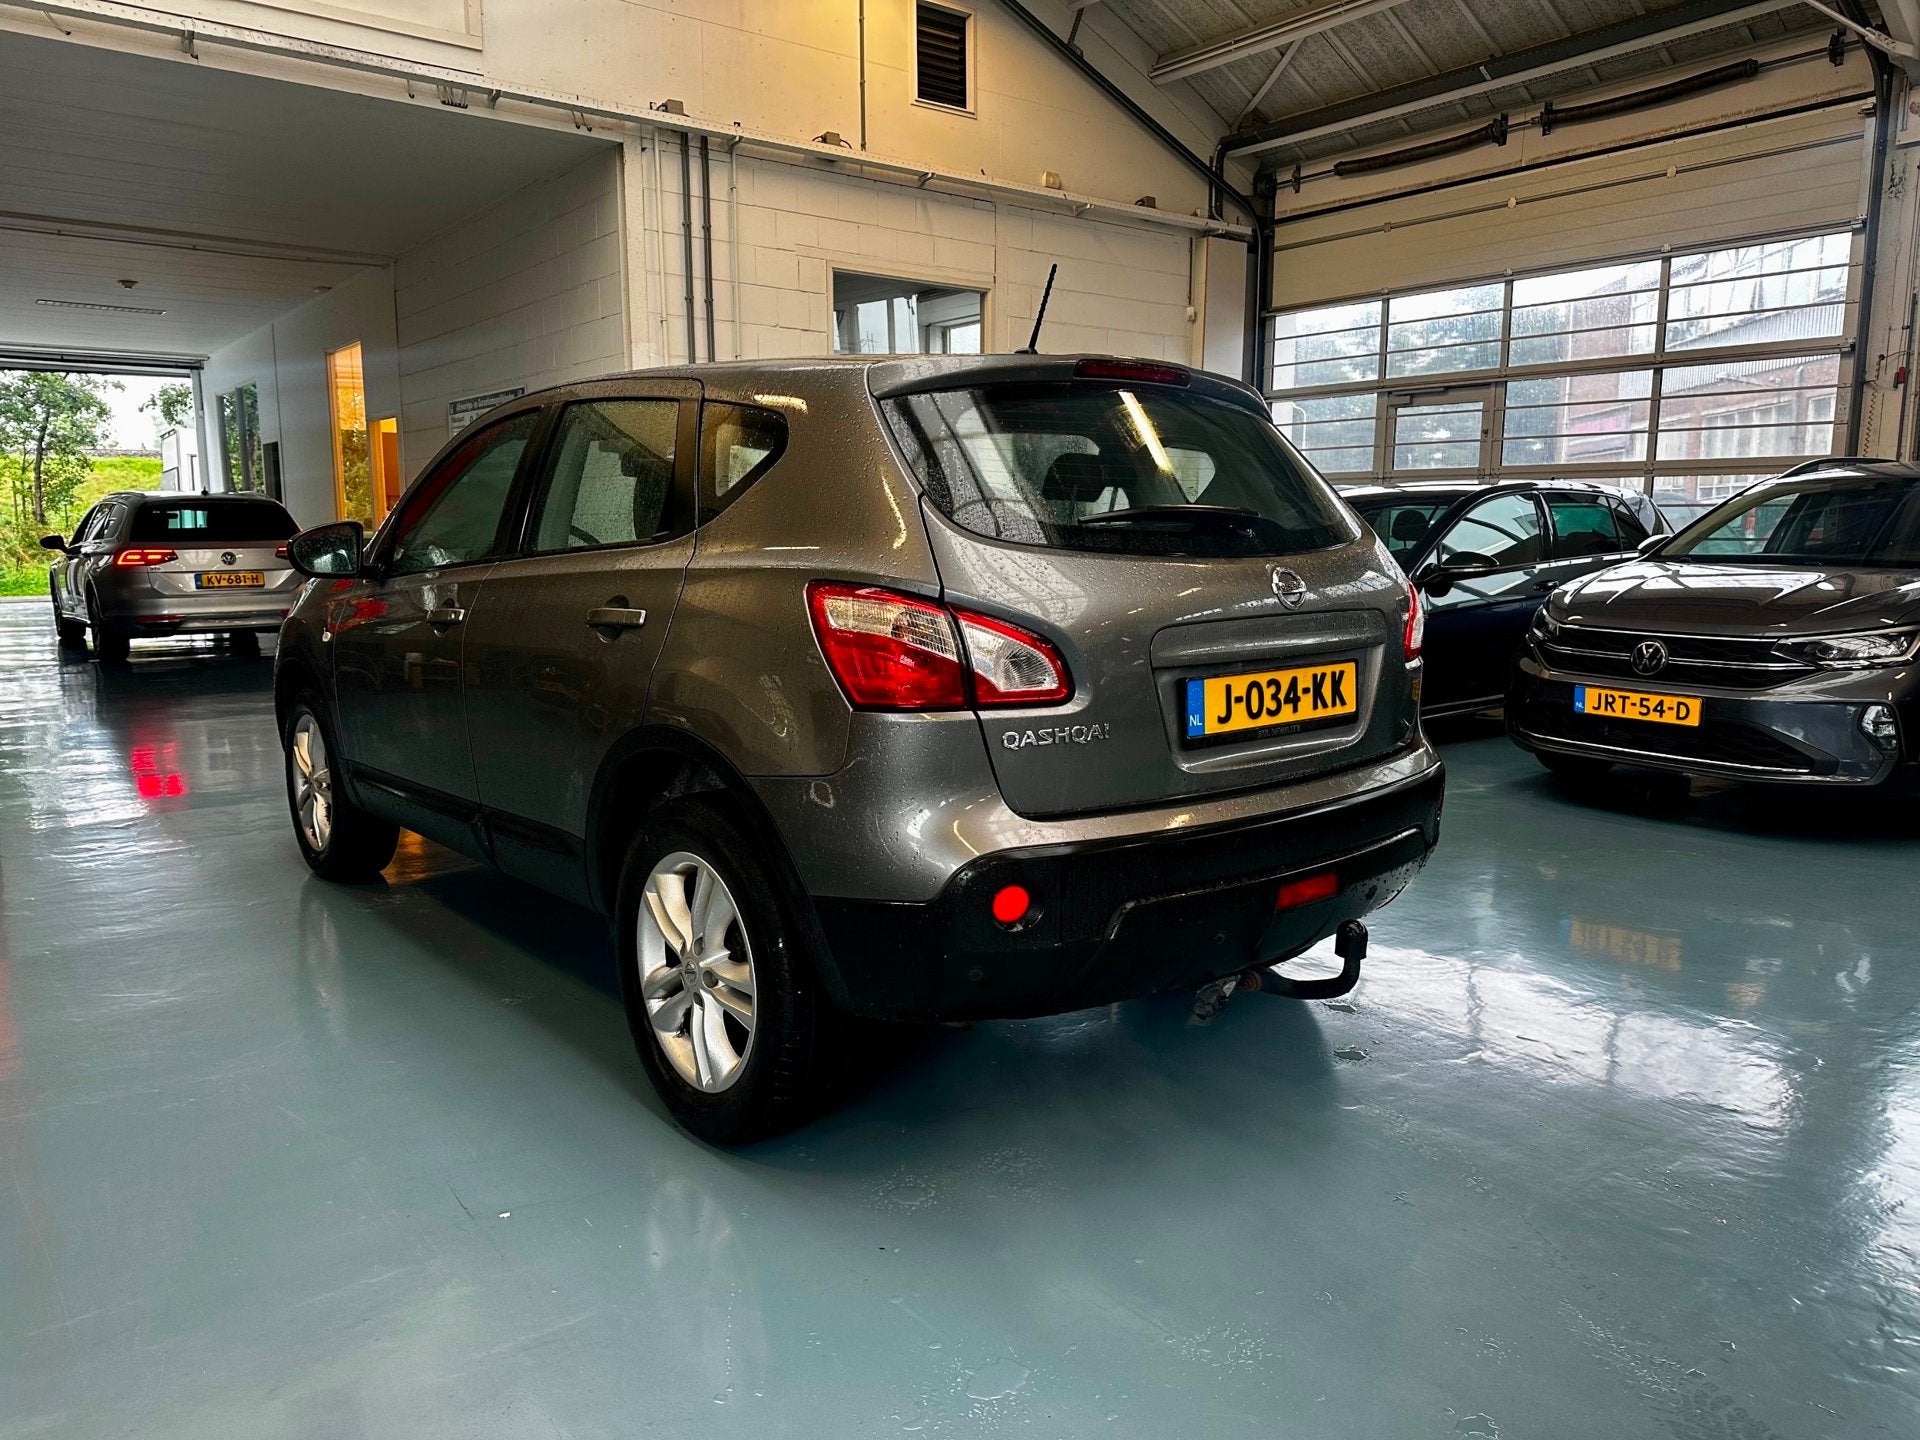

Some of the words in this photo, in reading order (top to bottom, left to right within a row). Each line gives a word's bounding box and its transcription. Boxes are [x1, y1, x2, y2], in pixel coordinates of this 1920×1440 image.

[206, 574, 259, 585] KV-681-H
[1217, 669, 1348, 724] J-034-KK
[1591, 692, 1691, 721] JRT-54-D
[1189, 714, 1202, 727] NL
[1001, 722, 1110, 751] QASHQAI
